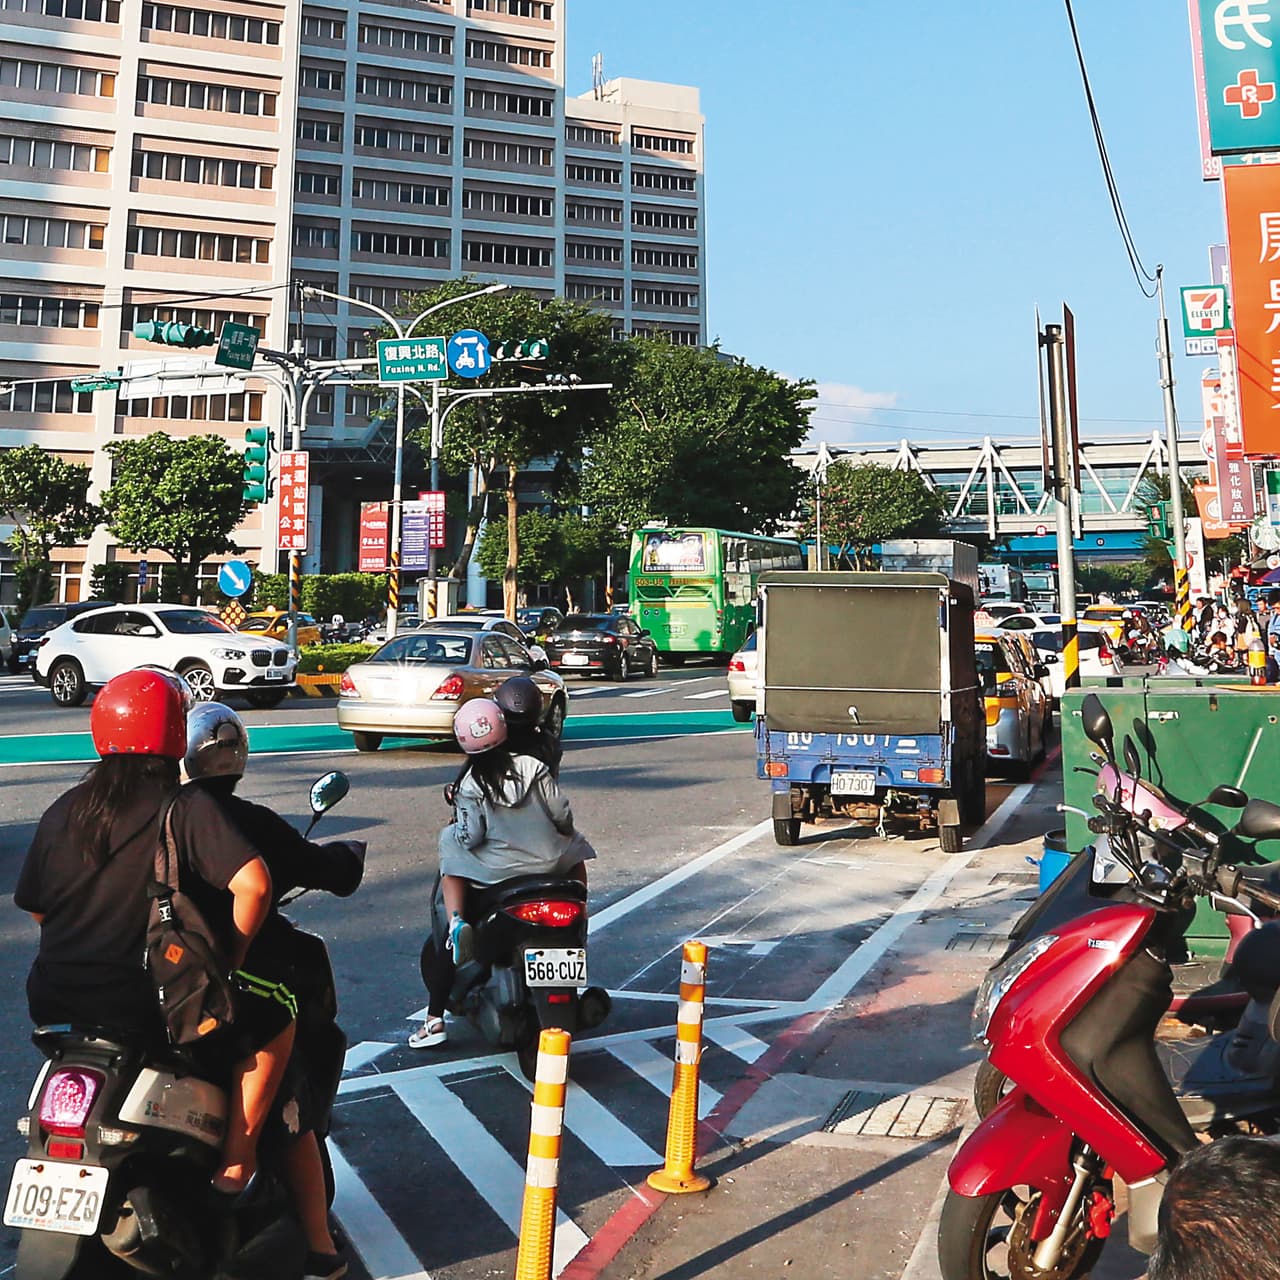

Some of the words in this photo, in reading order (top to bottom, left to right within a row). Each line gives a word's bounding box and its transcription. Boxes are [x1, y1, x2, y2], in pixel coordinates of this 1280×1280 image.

[384, 344, 439, 361] 復興北路
[385, 365, 415, 375] Fuxing
[280, 455, 293, 548] 限高4公尺
[292, 453, 306, 548] 捷運站區車輛
